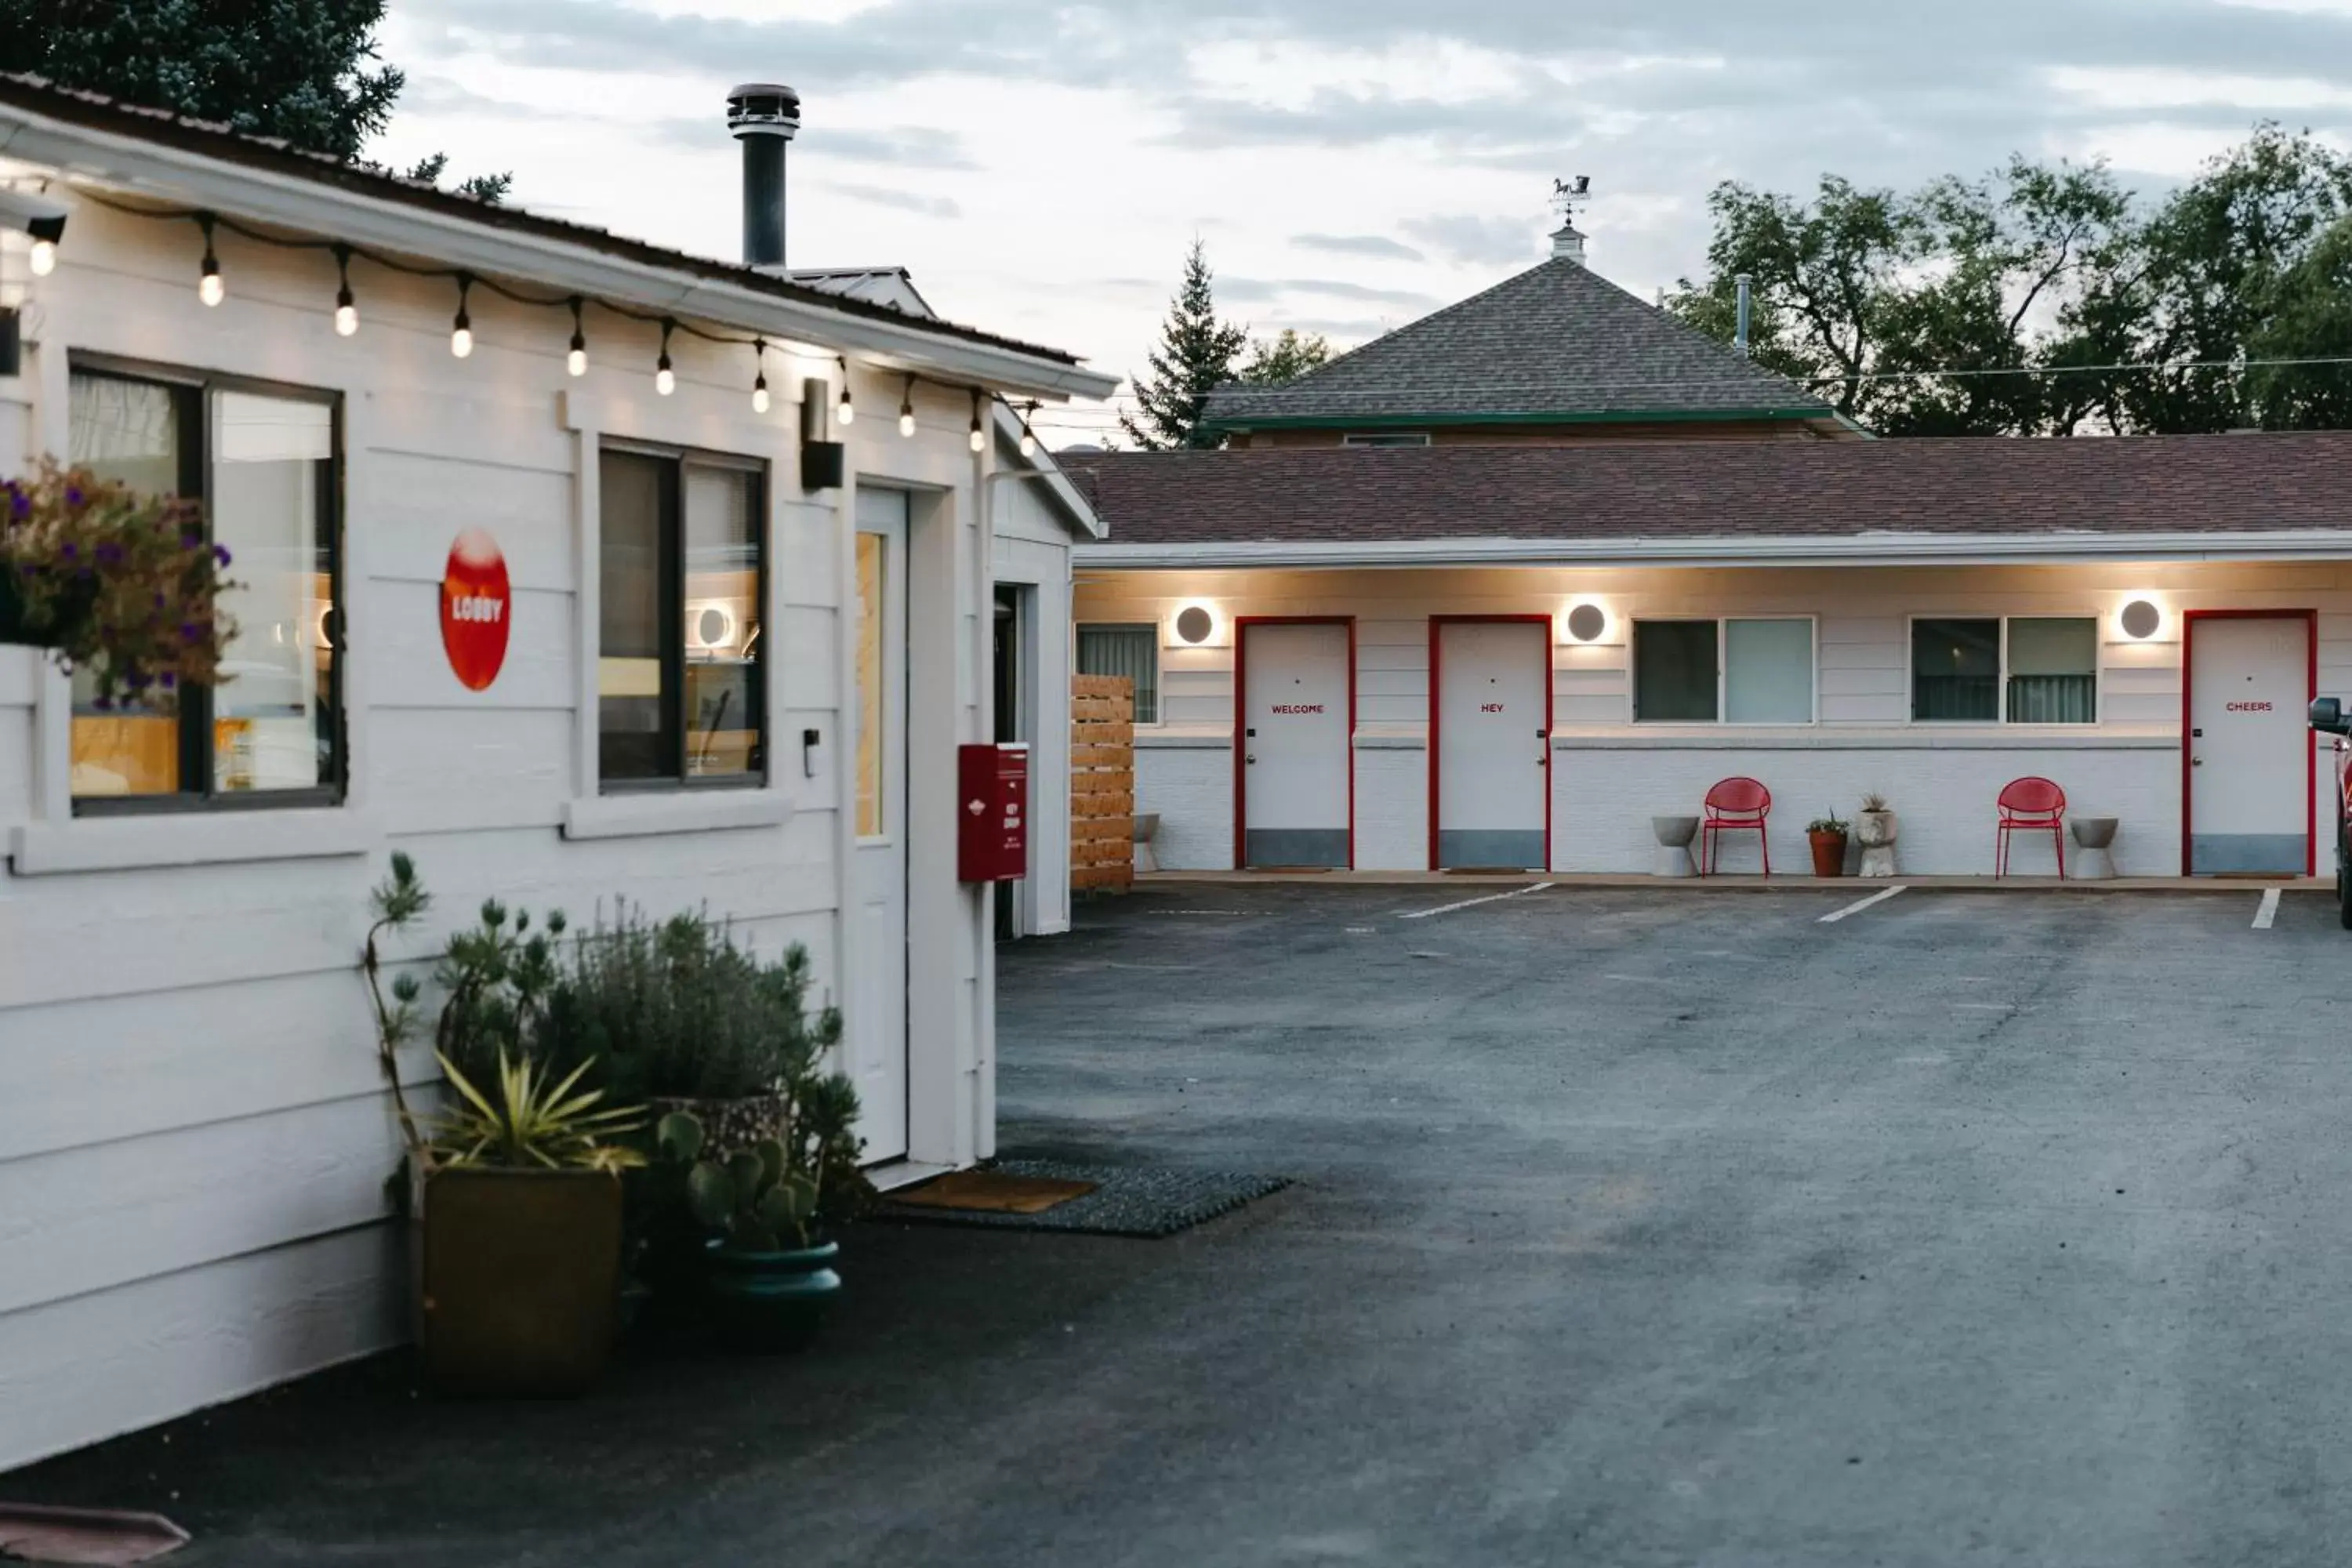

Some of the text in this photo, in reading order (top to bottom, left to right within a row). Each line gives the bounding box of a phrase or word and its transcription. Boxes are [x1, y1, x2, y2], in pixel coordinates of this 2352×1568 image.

[452, 596, 503, 622] LOBBY
[1272, 704, 1323, 714] WELCOME
[1481, 703, 1504, 713] HEY
[2226, 702, 2272, 712] CHEERS
